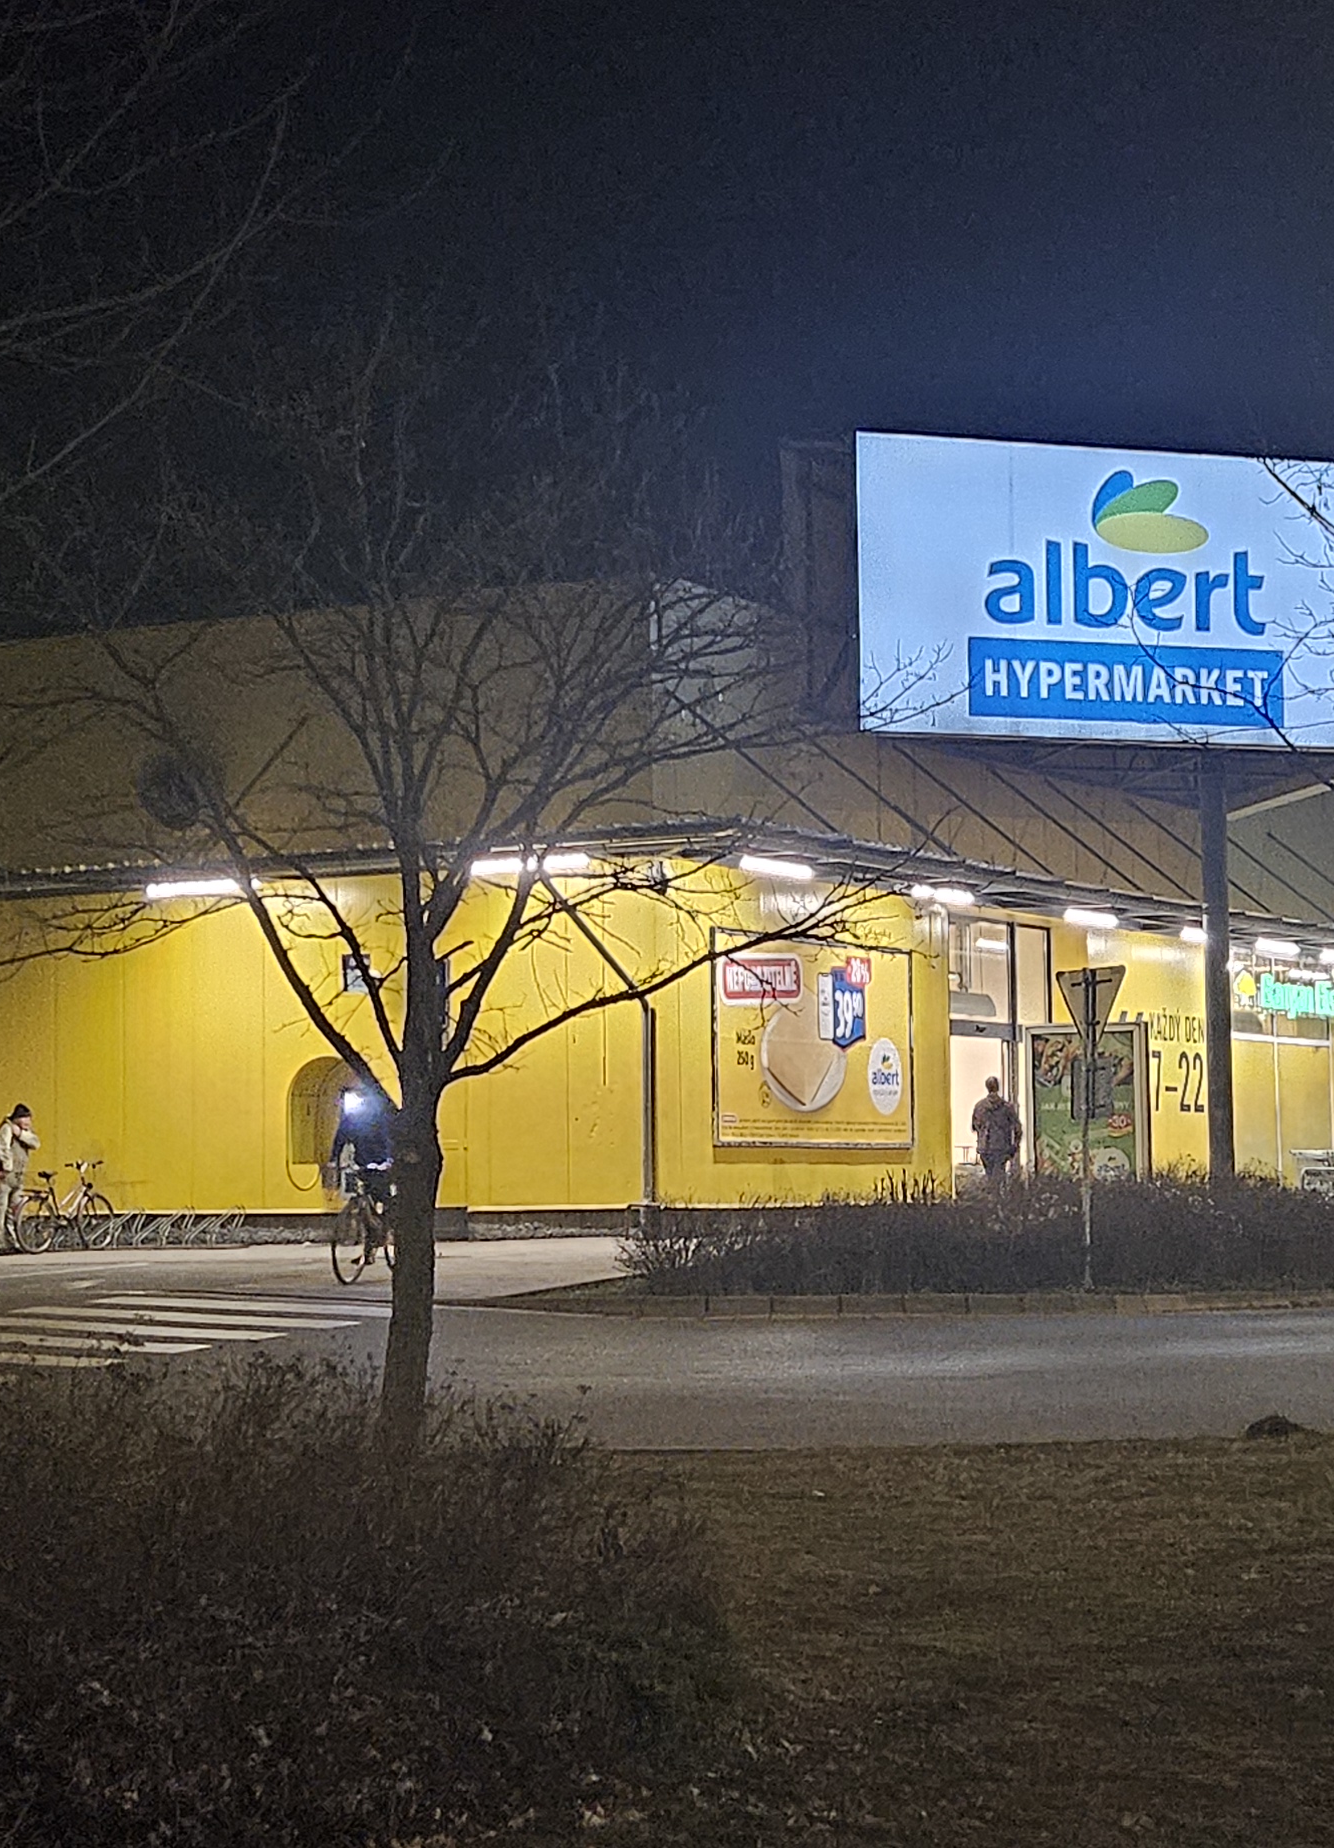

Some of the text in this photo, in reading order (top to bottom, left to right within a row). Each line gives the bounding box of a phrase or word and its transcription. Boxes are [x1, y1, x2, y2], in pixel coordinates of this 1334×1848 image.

[984, 539, 1266, 636] albert
[984, 658, 1268, 707] HYPERMARKET
[1260, 973, 1315, 1019] Banyan
[1148, 1007, 1204, 1043] KAŽDÝ DEN
[871, 1069, 900, 1086] albert
